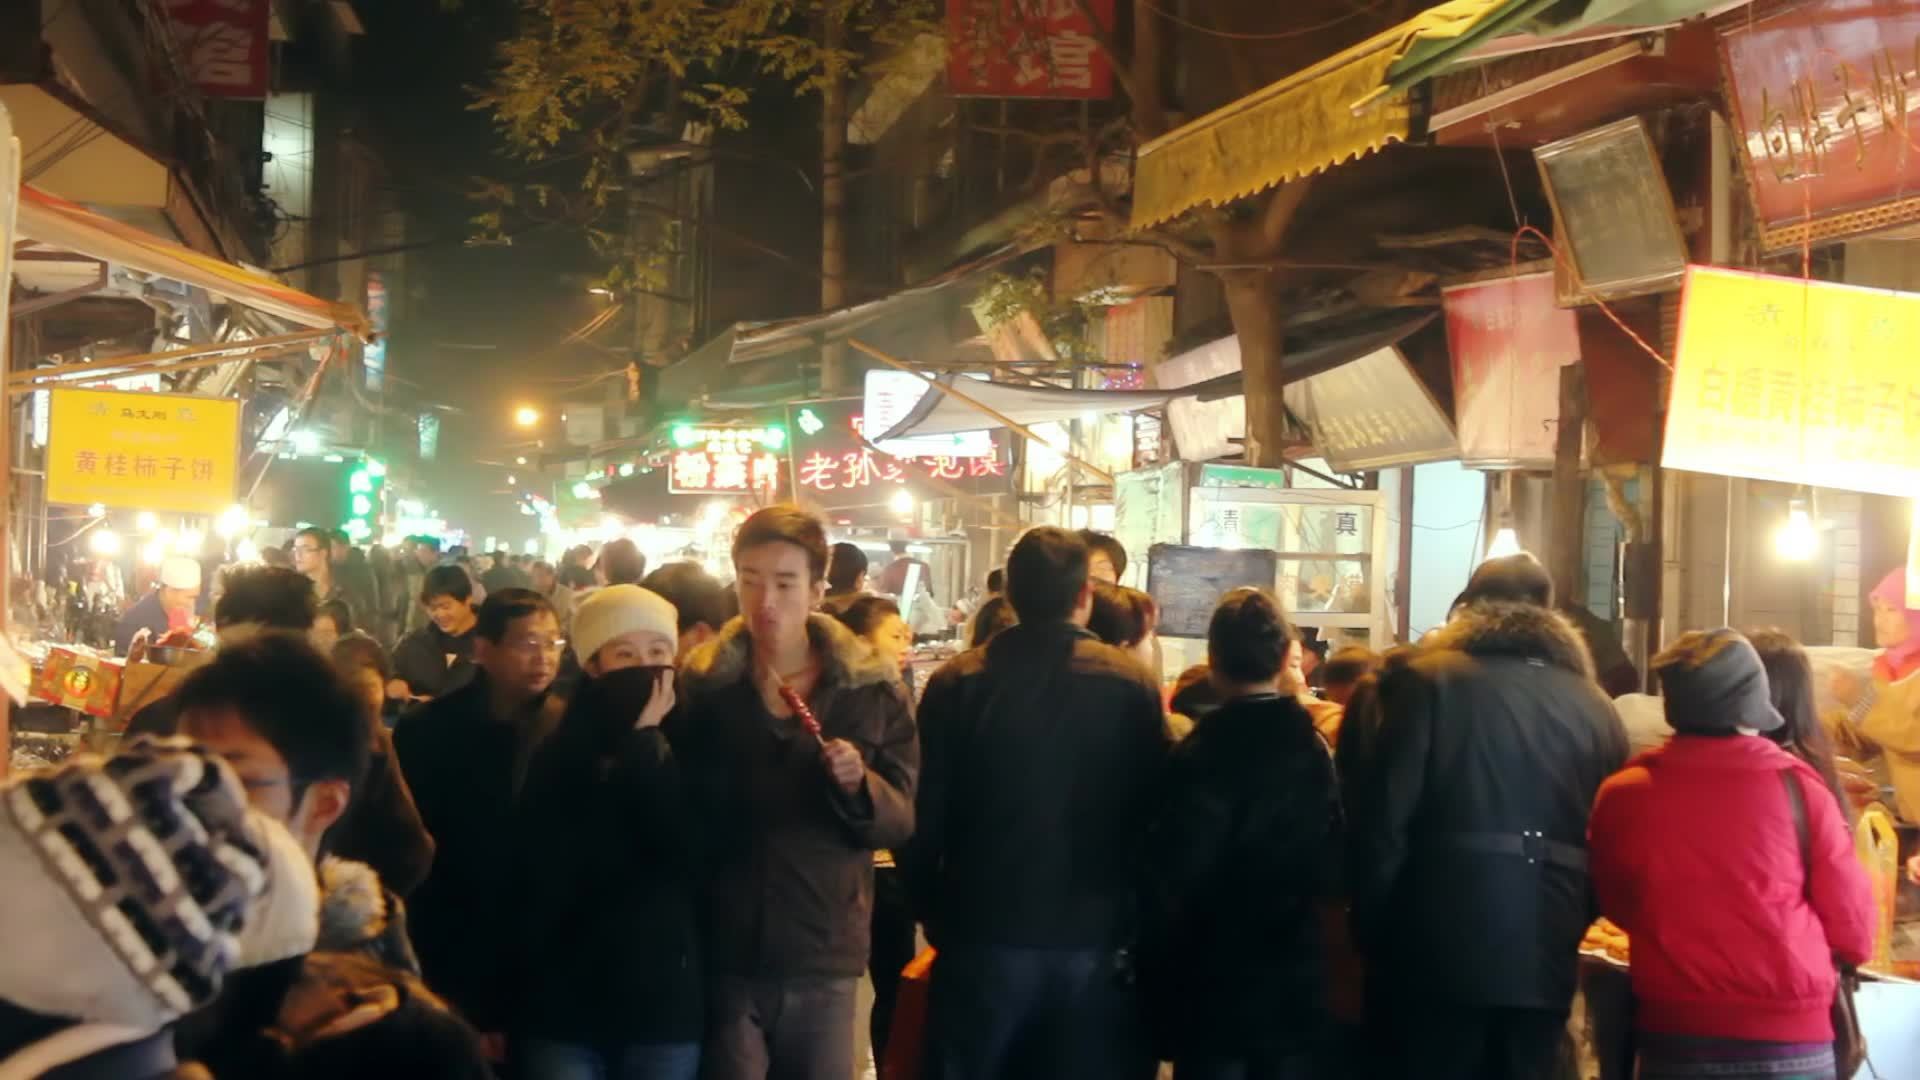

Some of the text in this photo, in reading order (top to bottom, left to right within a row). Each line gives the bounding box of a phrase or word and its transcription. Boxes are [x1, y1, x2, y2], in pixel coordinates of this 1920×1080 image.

[75, 450, 214, 481] 黄桂柿子饼
[1335, 511, 1358, 537] 真
